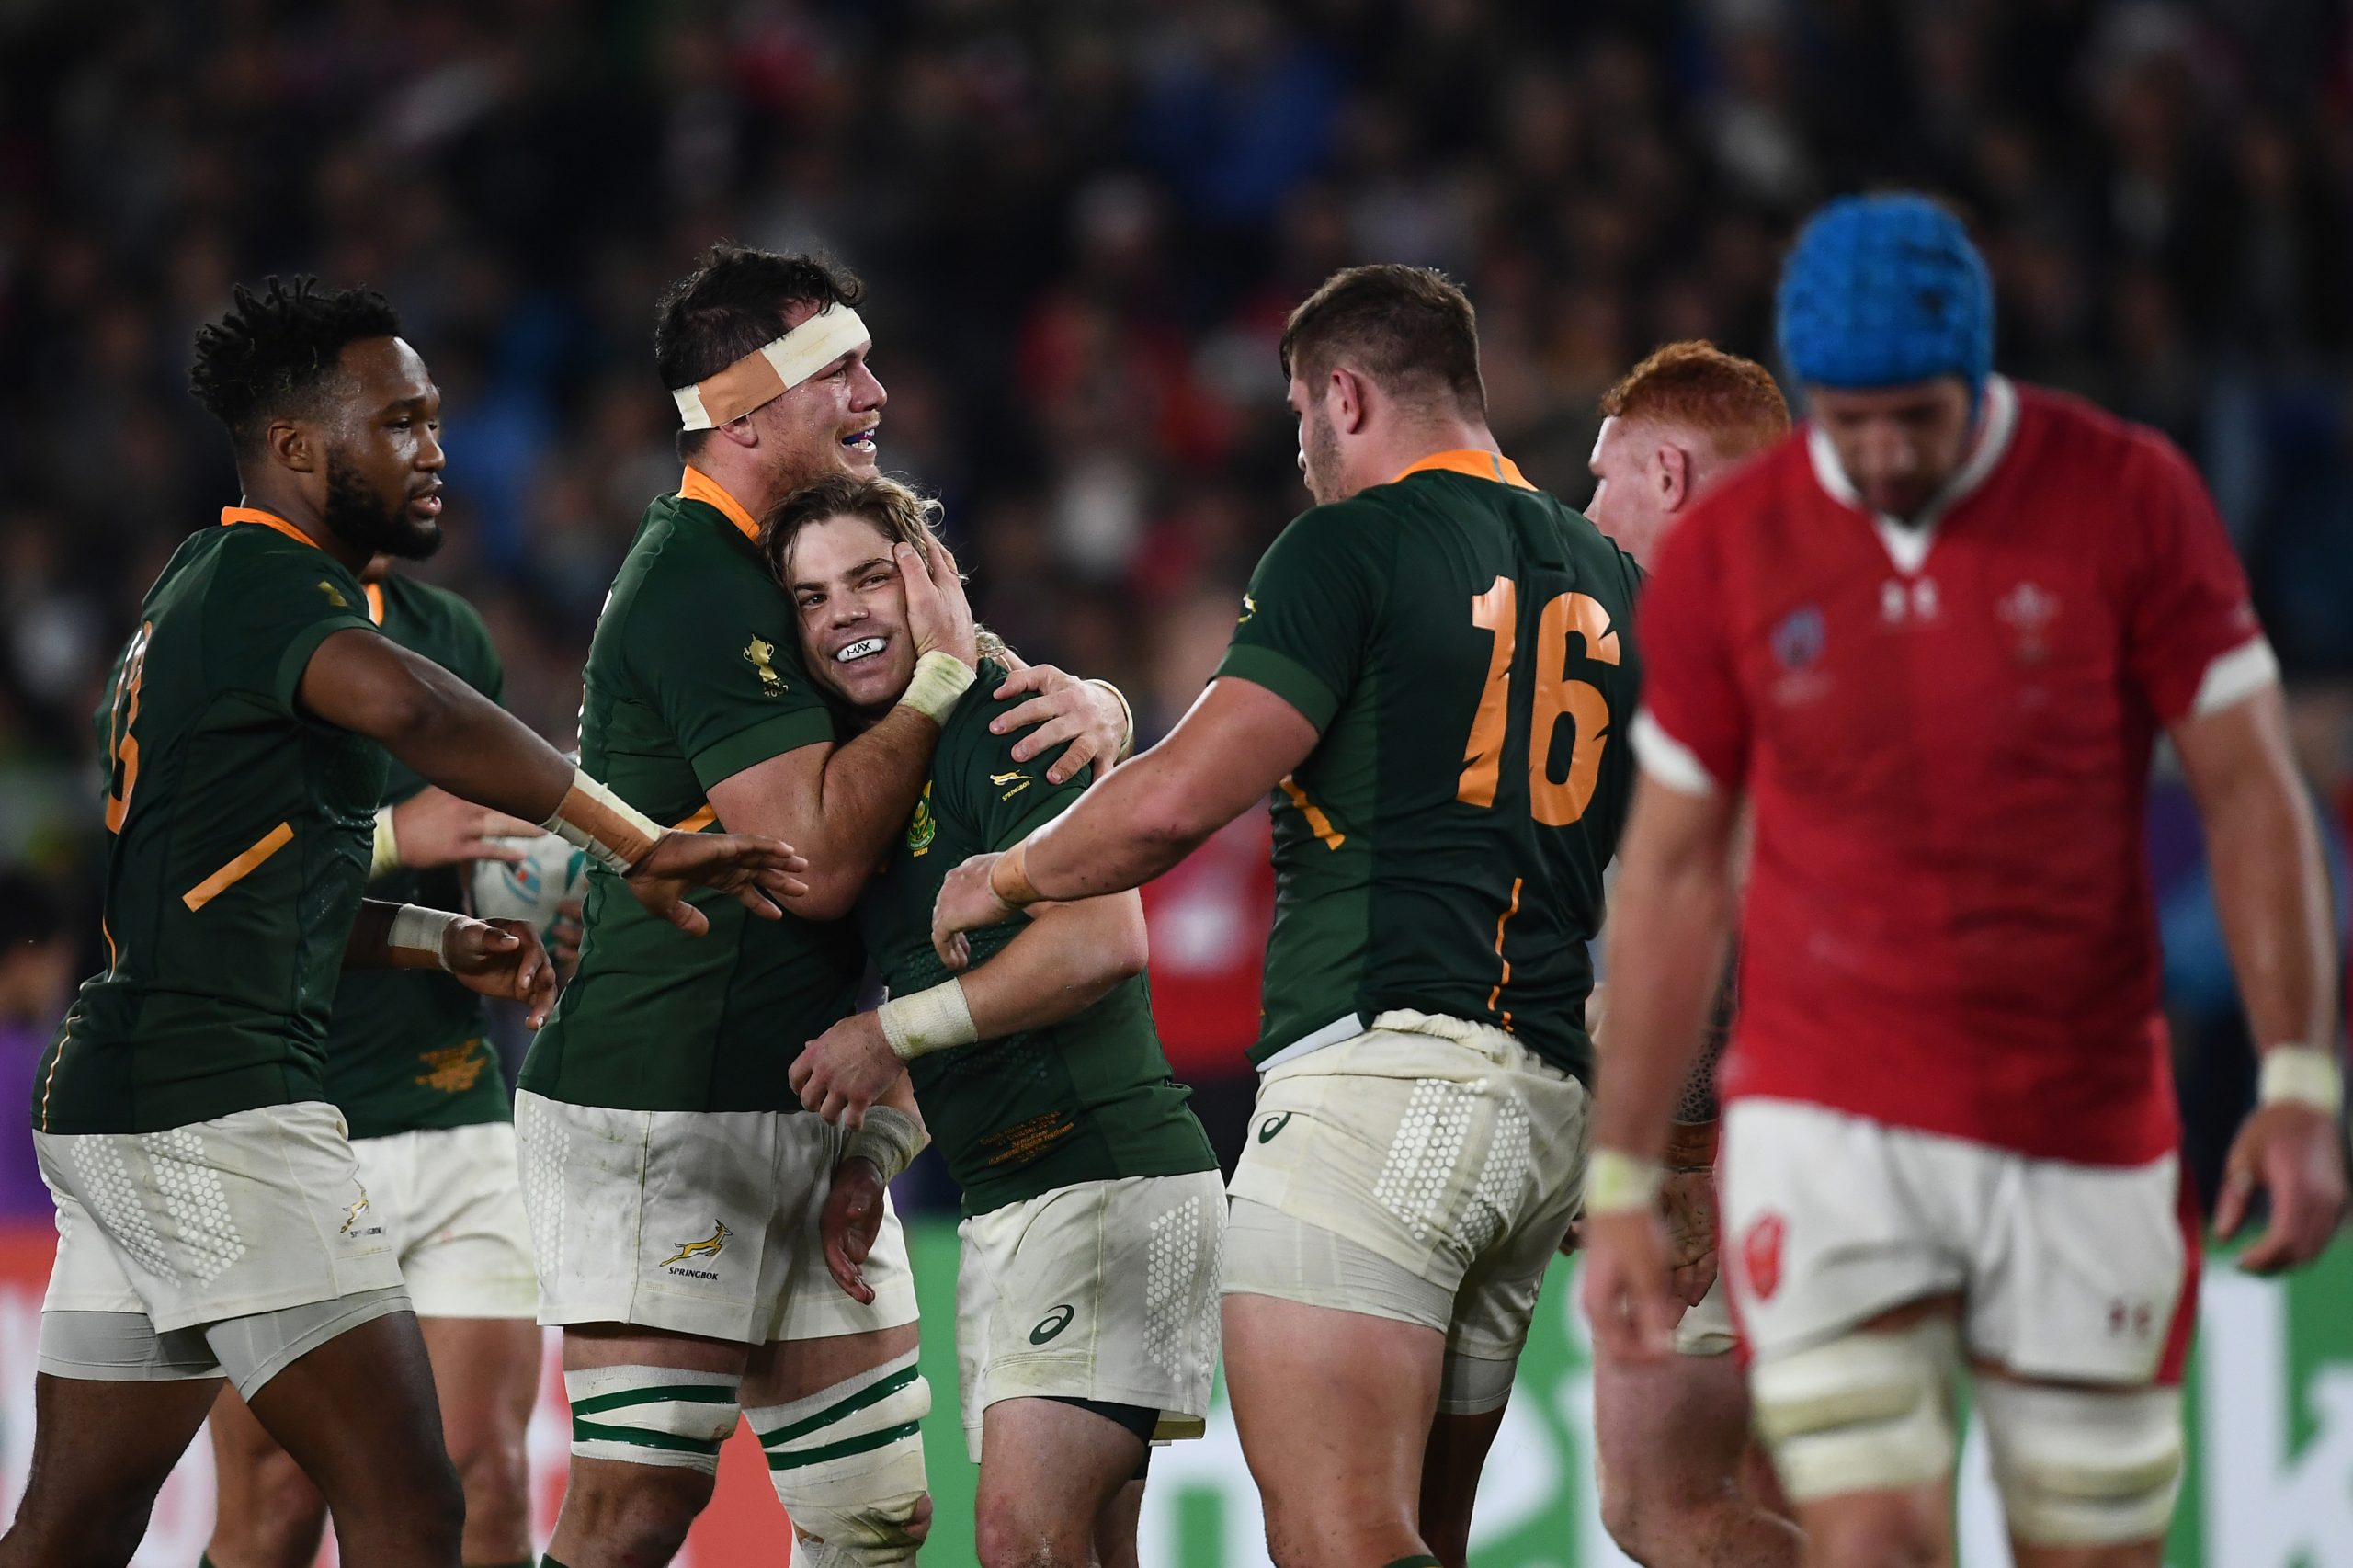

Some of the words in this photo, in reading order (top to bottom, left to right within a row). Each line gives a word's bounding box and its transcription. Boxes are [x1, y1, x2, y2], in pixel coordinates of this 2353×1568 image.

[846, 641, 871, 657] MAX
[1456, 574, 1620, 826] 16
[1002, 780, 1030, 801] SPRINGBOK
[668, 1267, 719, 1280] SPRINGBOK
